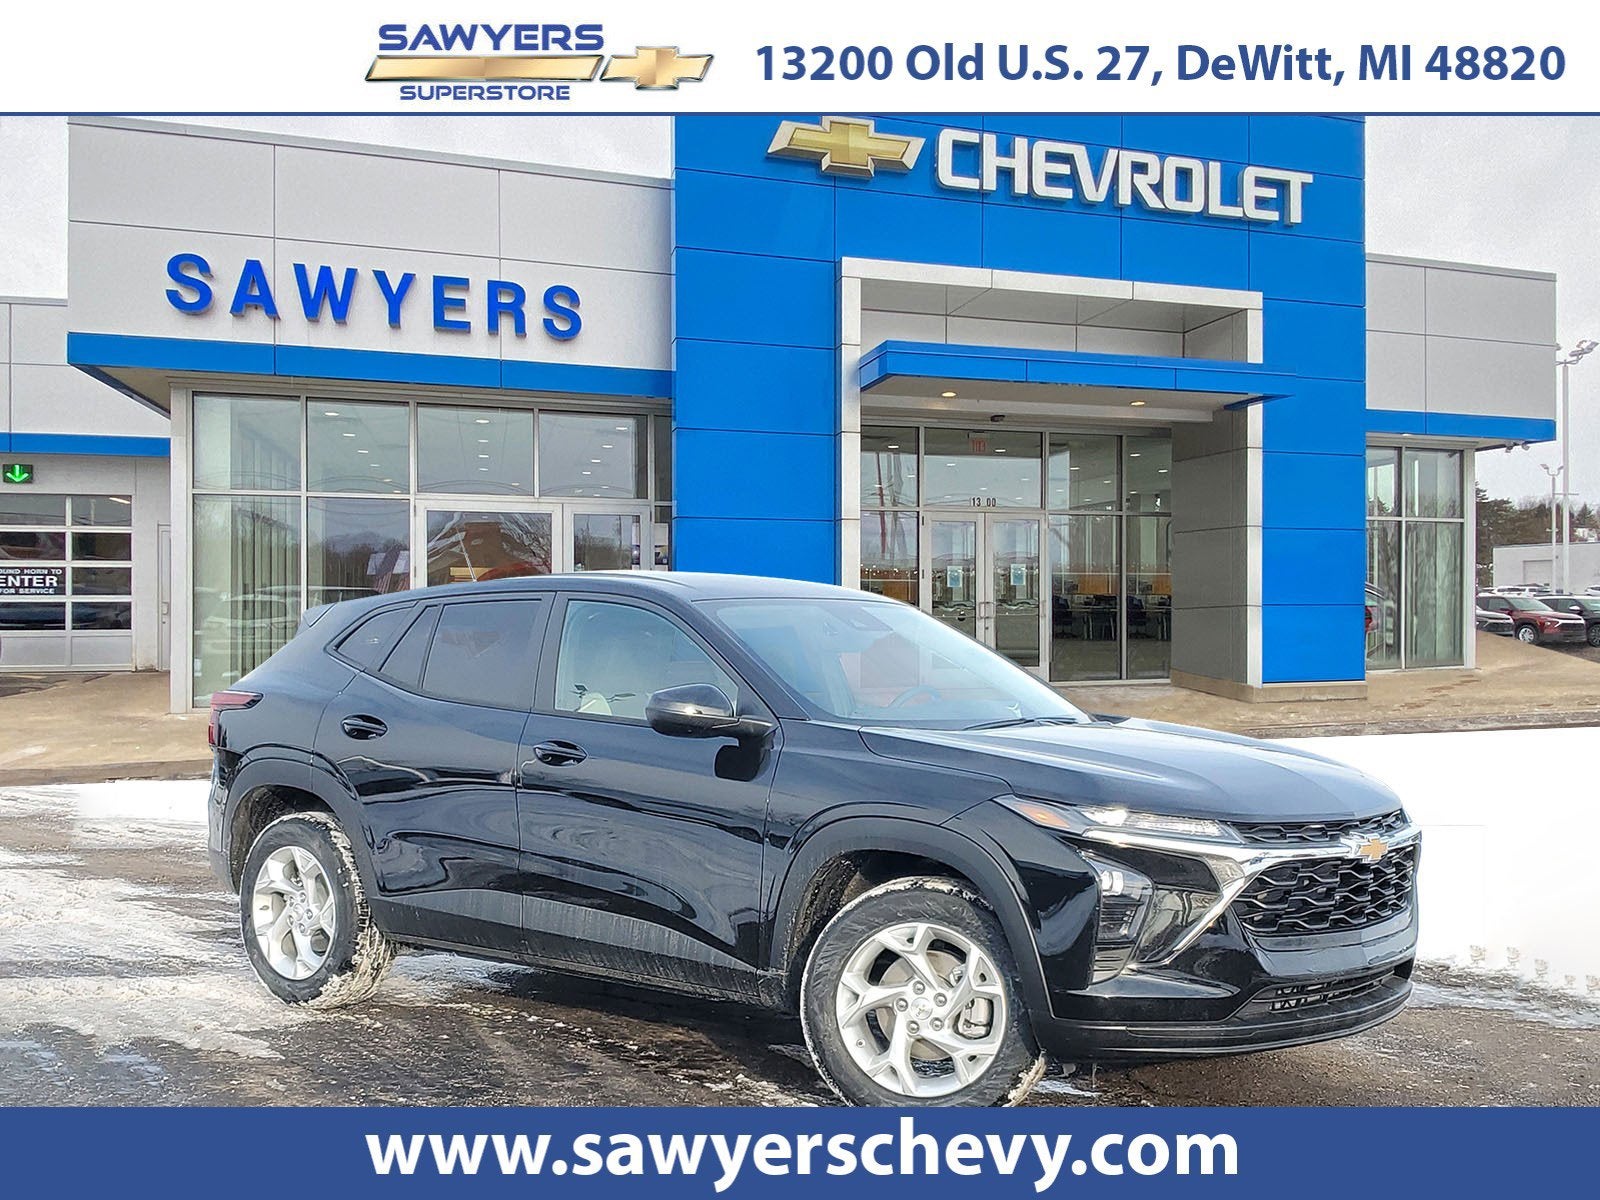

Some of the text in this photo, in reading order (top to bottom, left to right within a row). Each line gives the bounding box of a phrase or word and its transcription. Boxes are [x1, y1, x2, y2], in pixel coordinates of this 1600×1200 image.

[935, 128, 1314, 225] CHEVROLET
[165, 253, 583, 342] SAWYERS
[0, 575, 58, 587] ENTER
